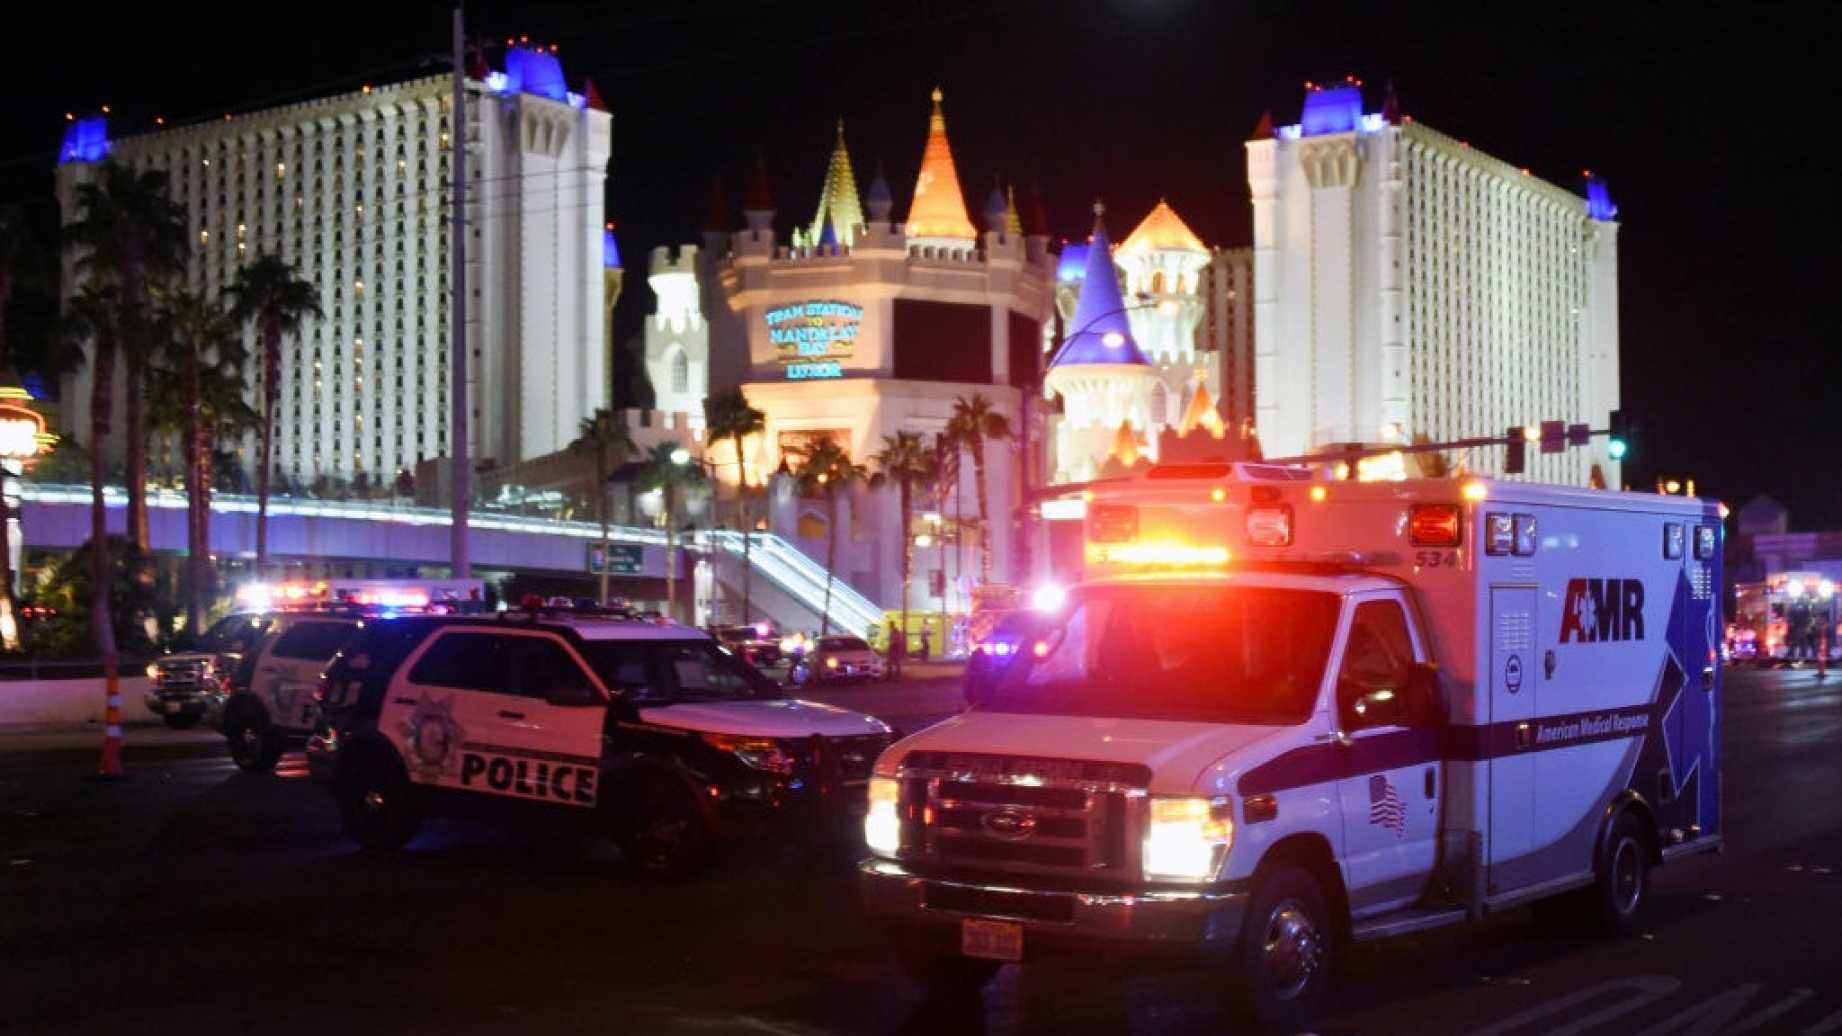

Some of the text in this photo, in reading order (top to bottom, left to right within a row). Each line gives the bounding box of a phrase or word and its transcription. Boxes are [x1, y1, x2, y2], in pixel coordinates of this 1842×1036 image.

[770, 325, 858, 343] MANDALAY
[1414, 551, 1457, 568] 534
[1558, 577, 1645, 643] AMR
[1536, 712, 1649, 744] American Medical Response
[462, 753, 596, 801] POLICE
